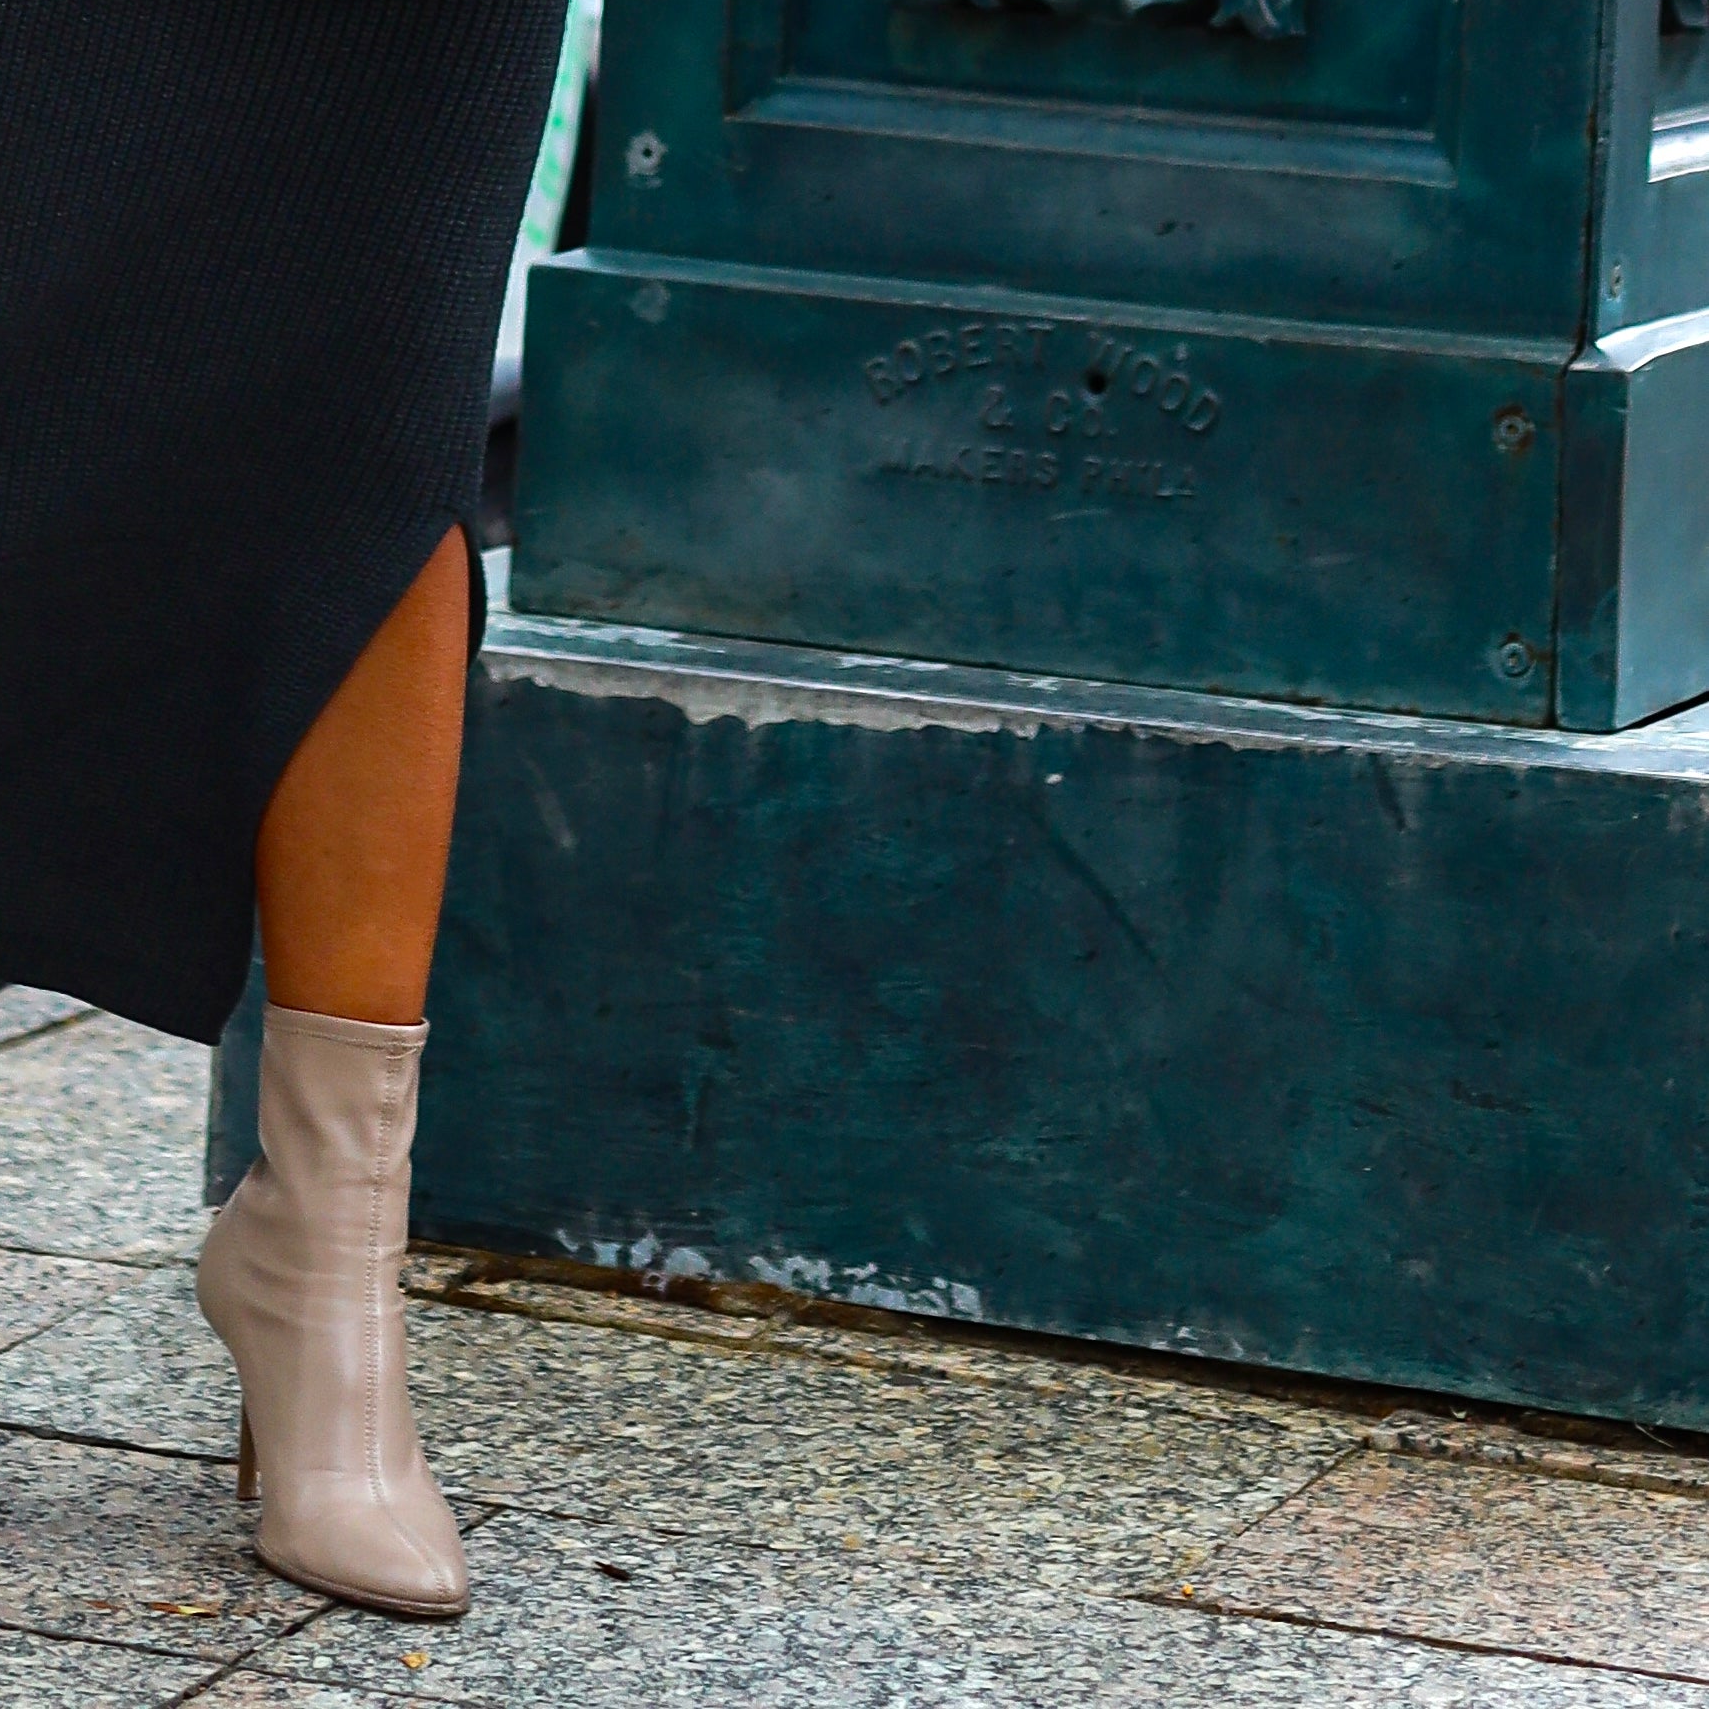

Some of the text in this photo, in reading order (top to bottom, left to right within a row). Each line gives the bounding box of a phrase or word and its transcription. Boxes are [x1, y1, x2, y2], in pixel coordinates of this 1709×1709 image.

[864, 321, 1222, 434] ROBERT WOOD
[979, 384, 1014, 430] &
